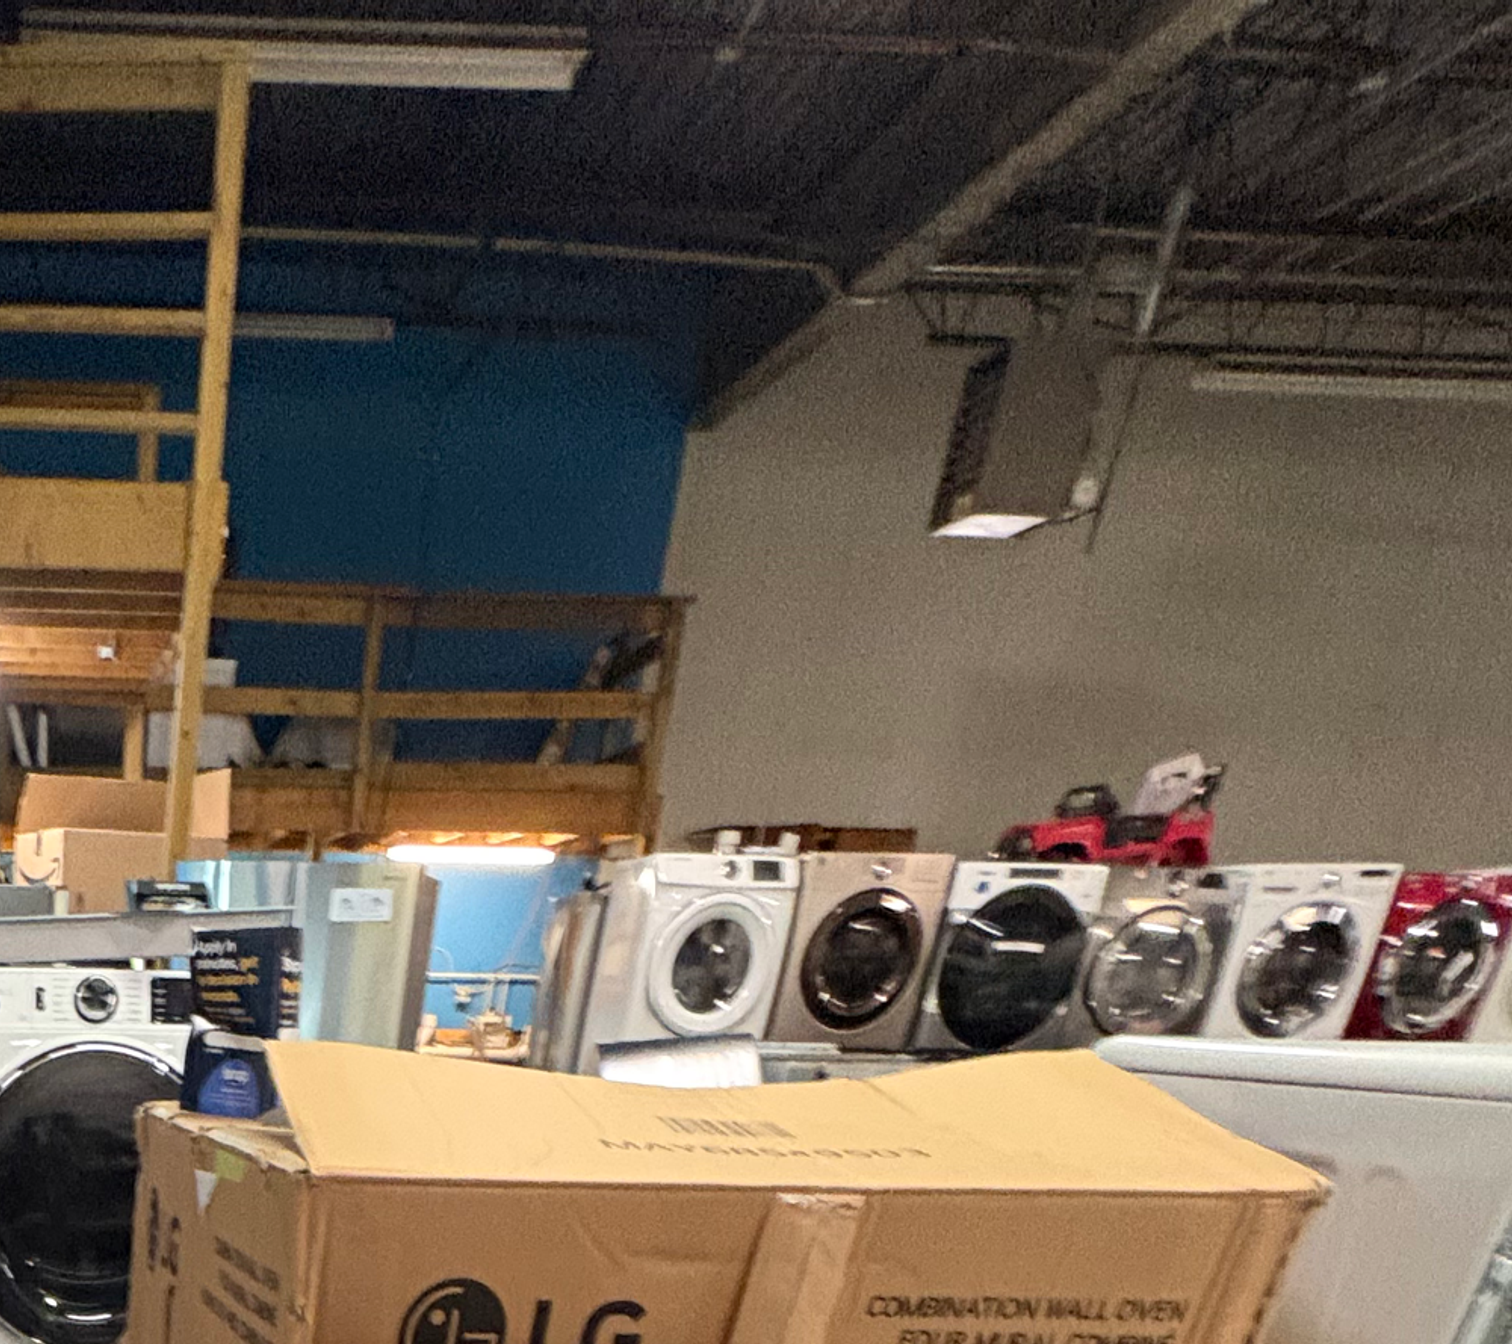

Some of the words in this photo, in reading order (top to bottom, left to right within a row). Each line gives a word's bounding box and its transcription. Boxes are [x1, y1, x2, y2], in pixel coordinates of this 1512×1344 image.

[866, 1295, 1037, 1319] COMBINATION
[1041, 1297, 1108, 1320] WALL
[1114, 1299, 1188, 1324] OVEN
